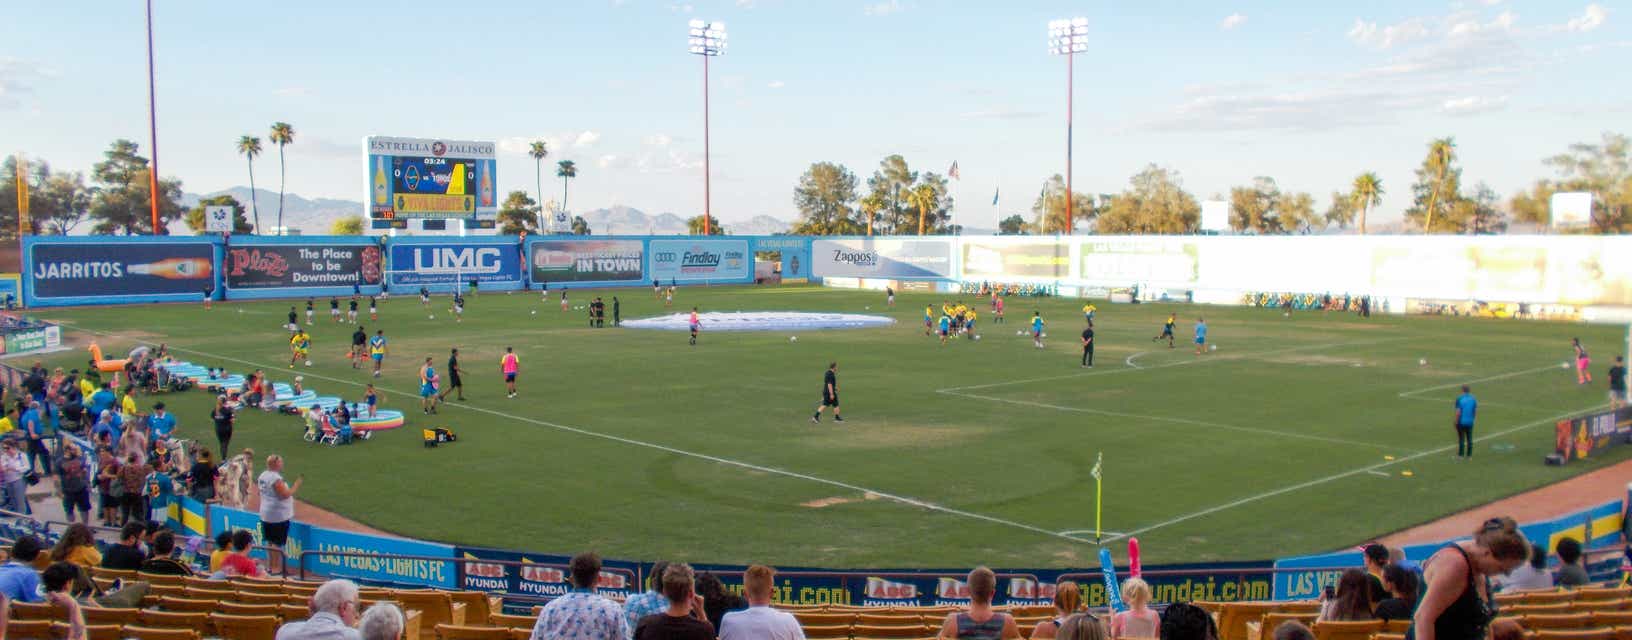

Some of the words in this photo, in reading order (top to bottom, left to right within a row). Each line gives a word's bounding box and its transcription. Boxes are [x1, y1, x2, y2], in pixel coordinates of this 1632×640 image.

[371, 141, 430, 152] ESTRELLA
[448, 144, 493, 154] JALISCO
[394, 169, 401, 177] 0
[467, 172, 474, 180] 0
[299, 249, 320, 259] The
[323, 249, 352, 259] Place
[682, 251, 721, 265] Findlay
[834, 249, 872, 264] Zappos
[312, 261, 323, 271] to
[327, 260, 341, 271] be
[415, 248, 501, 274] UMC
[577, 259, 593, 272] IN
[595, 259, 641, 272] TOWN
[35, 262, 123, 280] JARRITOS
[293, 271, 360, 283] Downtown!
[319, 543, 341, 566] LAS
[343, 546, 379, 572] VEGAS
[385, 552, 428, 578] LIGHTS
[428, 559, 445, 583] FC
[1287, 572, 1314, 597] LAS
[873, 585, 914, 598] ABC
